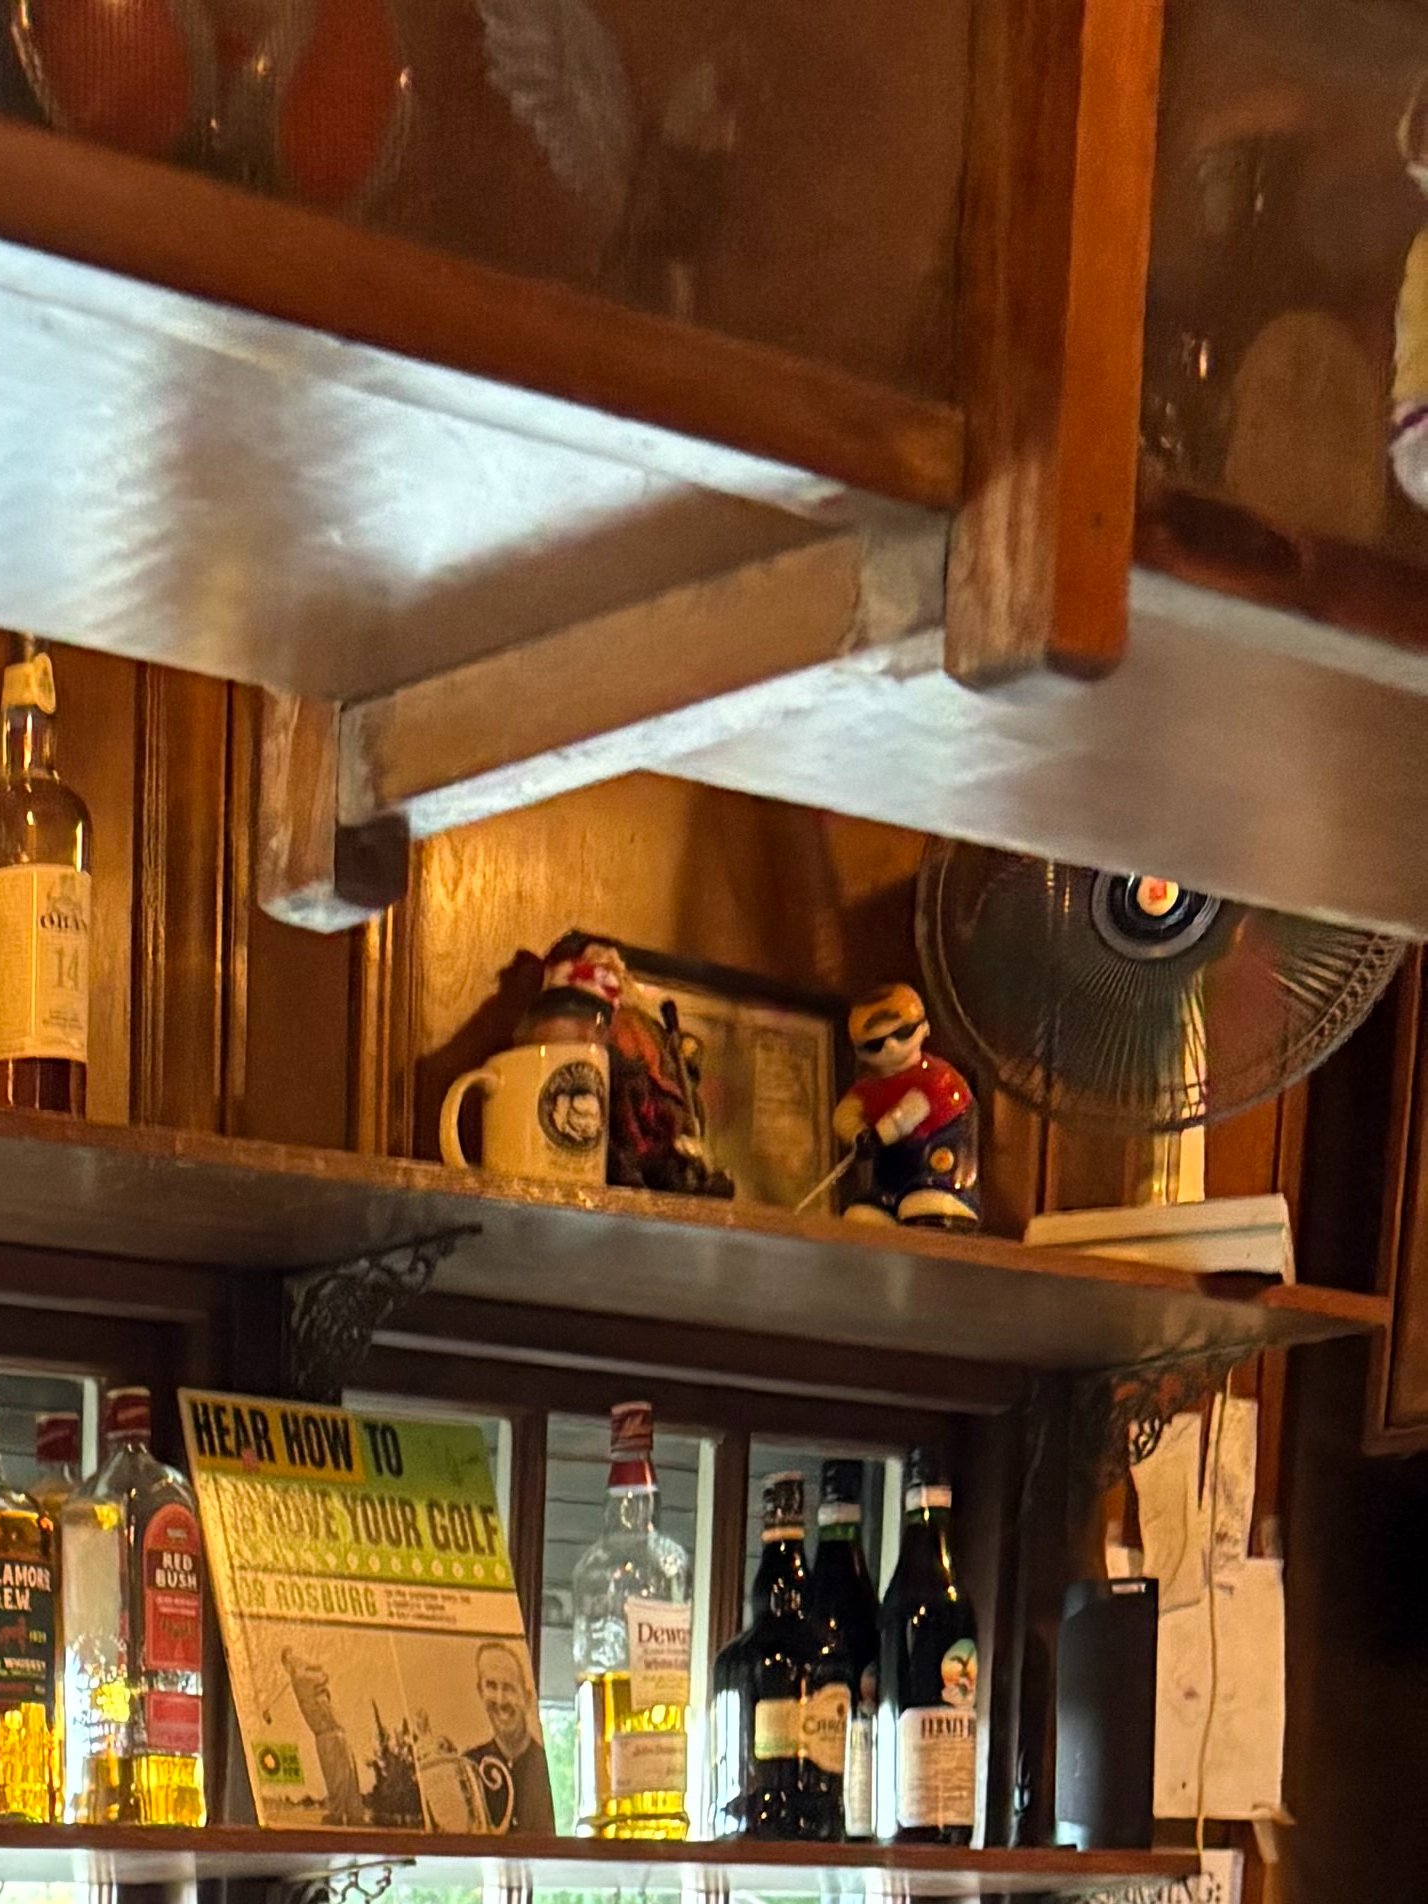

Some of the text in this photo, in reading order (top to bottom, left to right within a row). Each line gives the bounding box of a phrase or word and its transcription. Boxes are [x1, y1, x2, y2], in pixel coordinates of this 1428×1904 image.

[190, 1401, 403, 1478] HEAR HOW TO
[341, 1491, 424, 1549] YOUR
[425, 1499, 498, 1556] GOLF
[155, 1569, 197, 1591] BUSH
[162, 1552, 193, 1571] RED
[275, 1579, 378, 1618] ROSBURG
